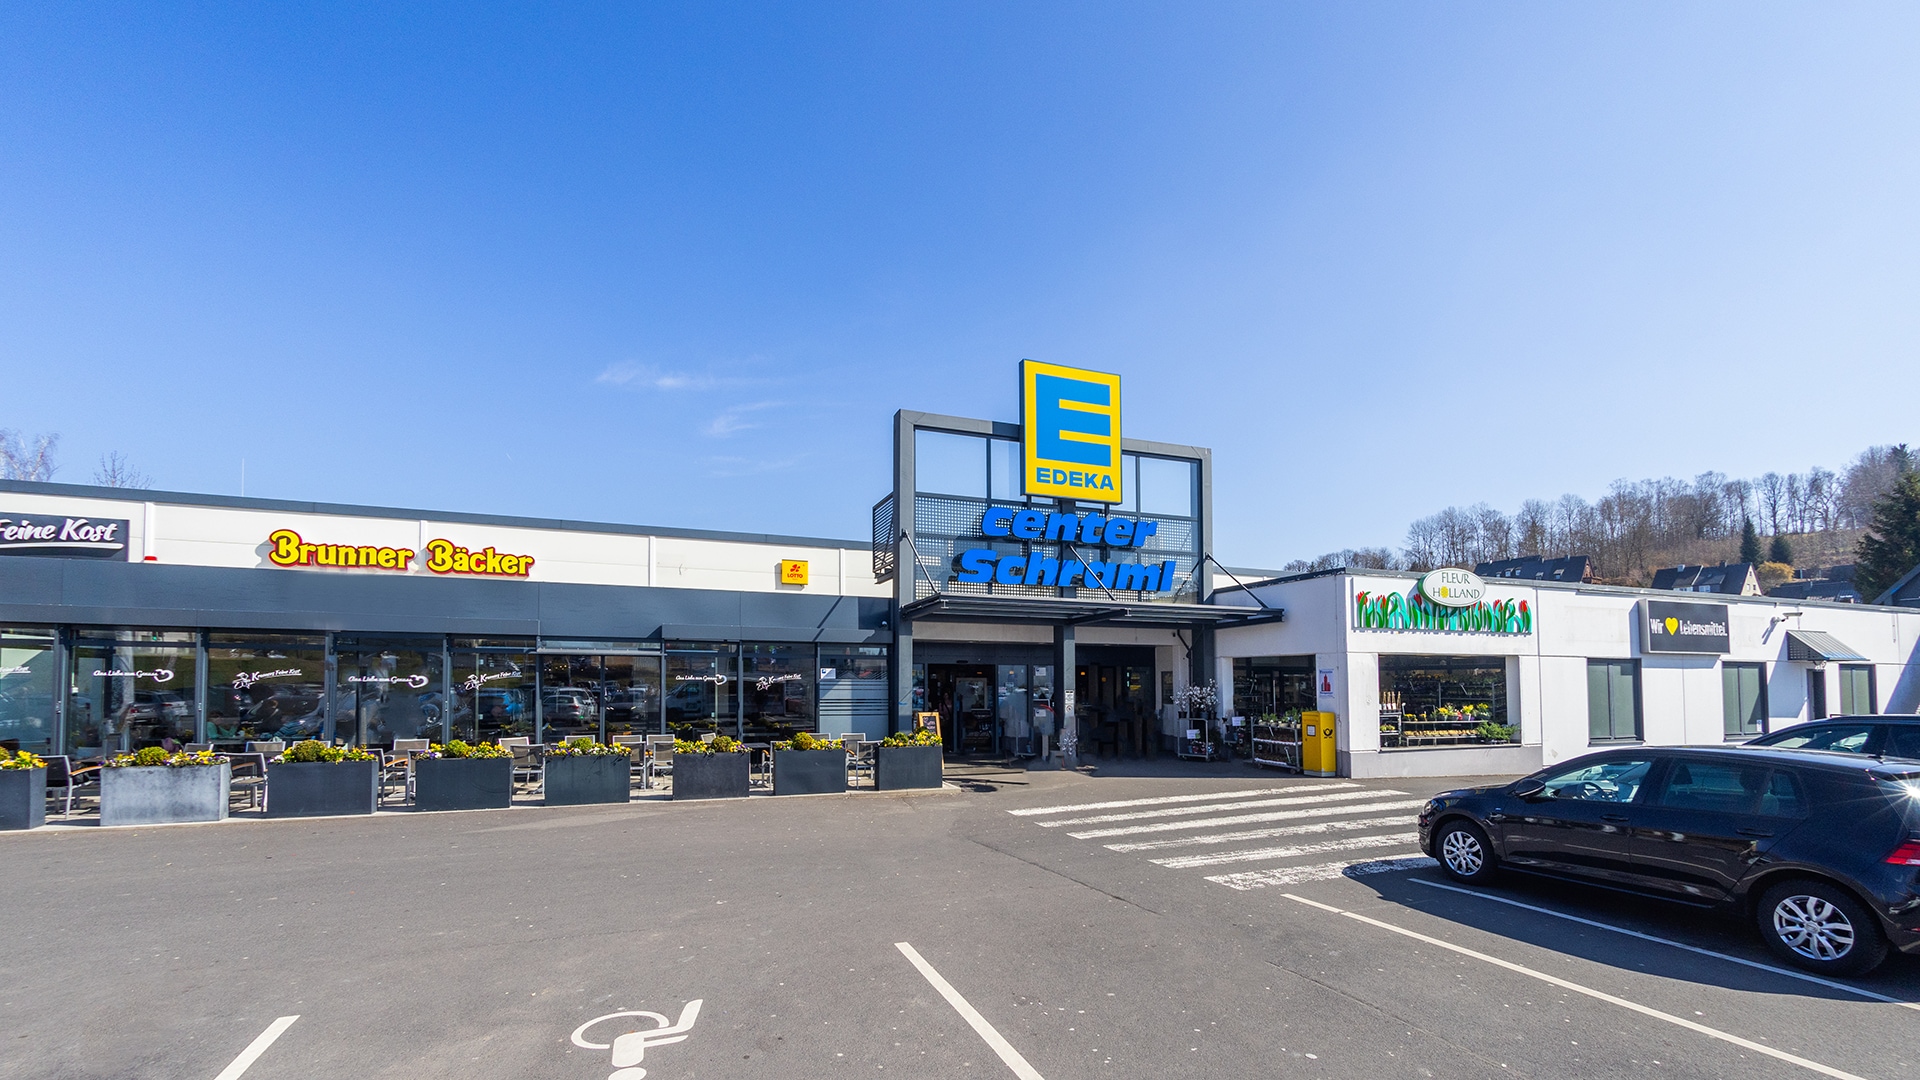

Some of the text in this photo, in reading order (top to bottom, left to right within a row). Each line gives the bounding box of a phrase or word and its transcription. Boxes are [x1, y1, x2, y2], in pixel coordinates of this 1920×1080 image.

[1036, 467, 1115, 491] EDEKA
[59, 518, 119, 542] Kost
[982, 507, 1157, 547] center
[269, 529, 536, 576] Brunner Bäcker
[957, 548, 1177, 591] Schraml
[1441, 572, 1470, 584] FLEUR
[1433, 586, 1480, 599] HOLLAND
[1650, 618, 1664, 634] Wir
